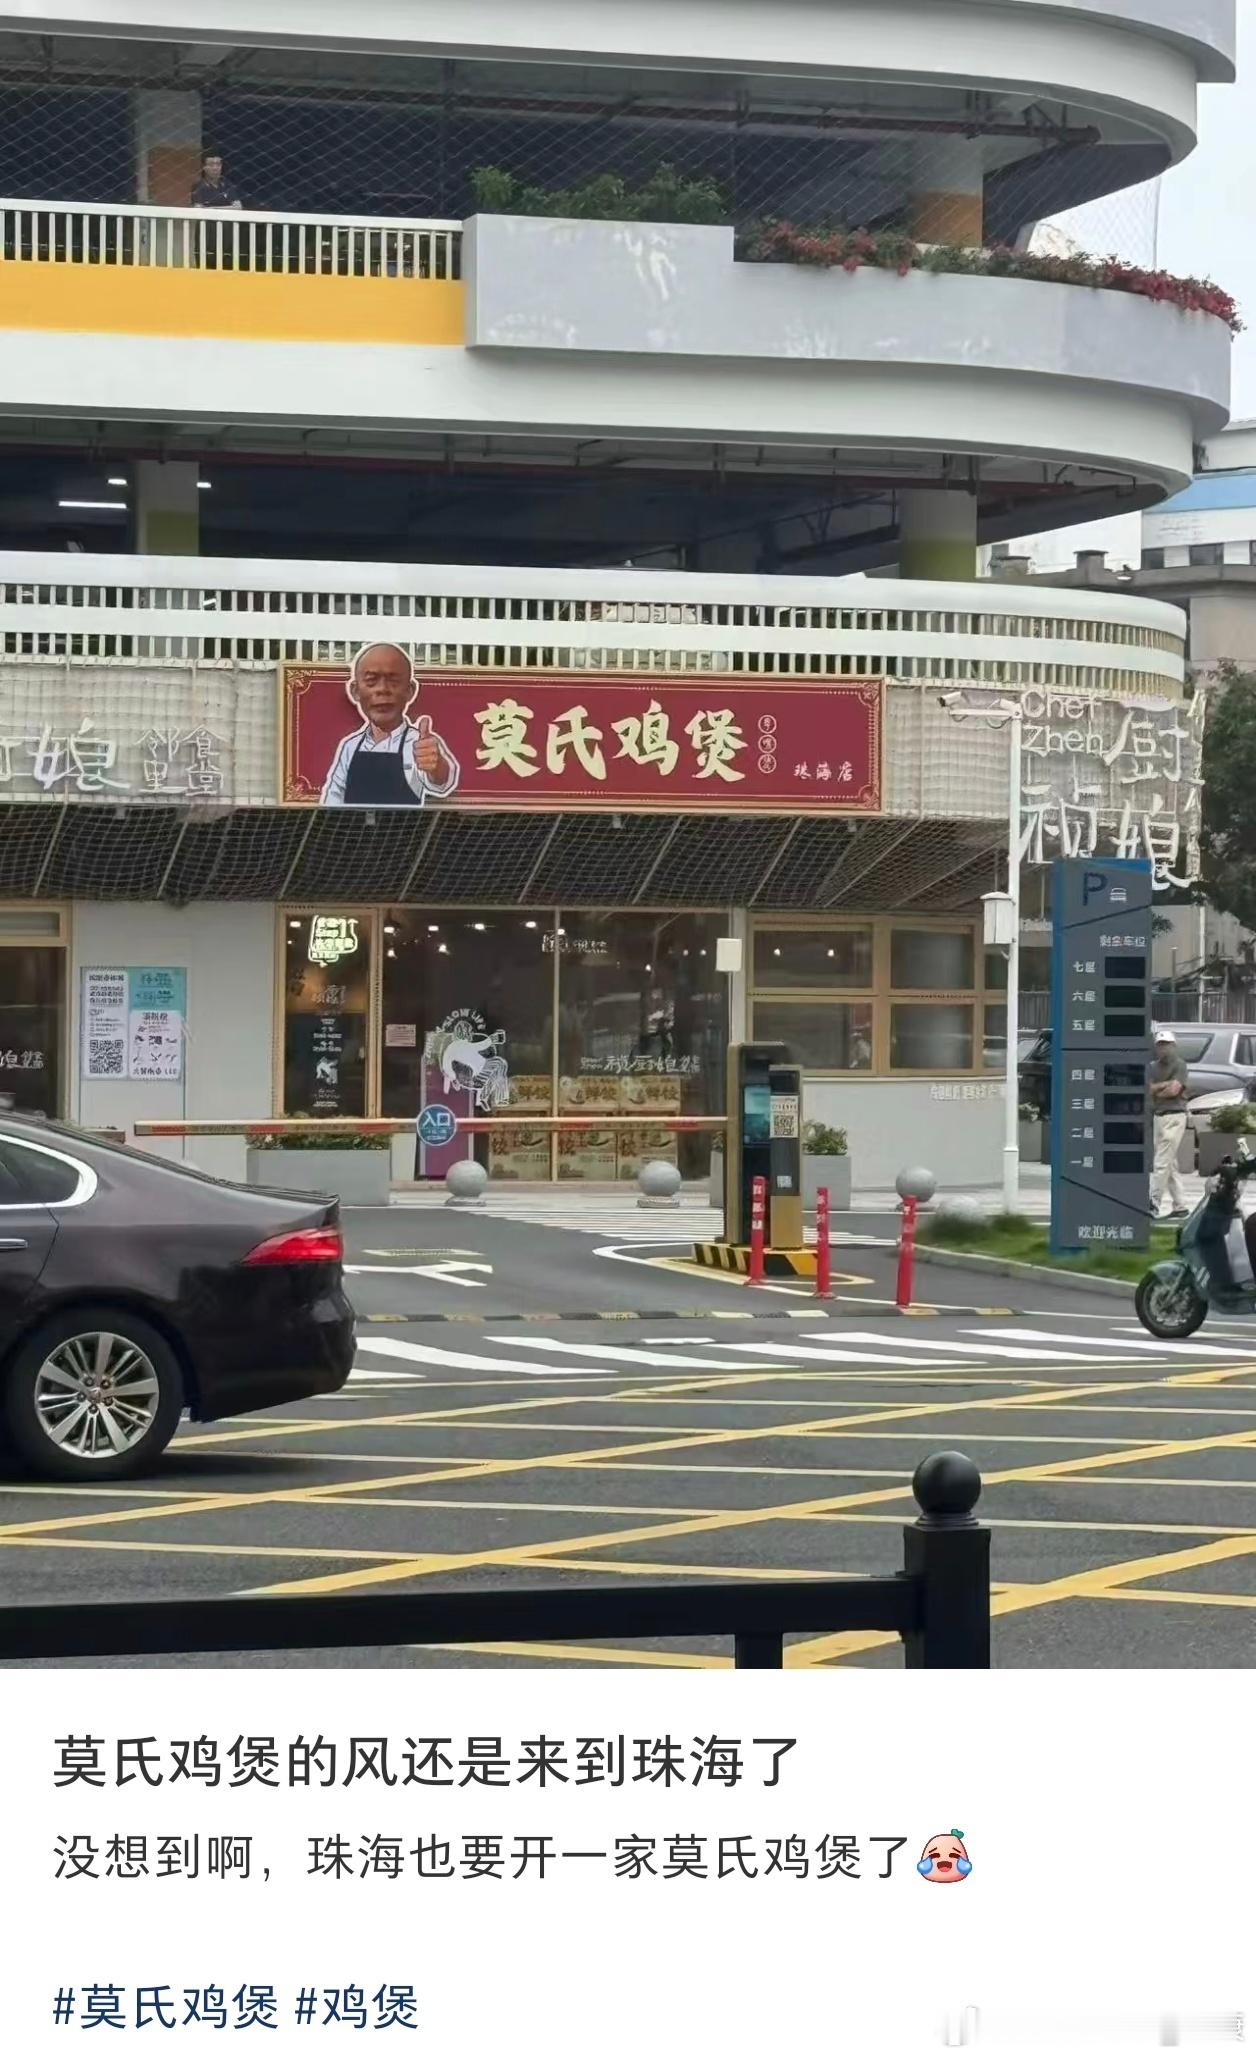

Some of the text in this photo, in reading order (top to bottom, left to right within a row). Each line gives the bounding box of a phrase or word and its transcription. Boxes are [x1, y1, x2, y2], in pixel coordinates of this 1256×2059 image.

[1021, 689, 1102, 719] Chef
[473, 698, 749, 783] 莫氏鸡煲
[1021, 724, 1103, 756] Zhen
[793, 761, 854, 782] 珠海店
[1083, 873, 1107, 906] P
[1099, 935, 1146, 947] 剩余车位
[1073, 961, 1096, 973] 七层
[1072, 991, 1096, 1002] 六层
[1072, 1019, 1096, 1031] 五层
[1071, 1069, 1095, 1081] 四层
[1071, 1098, 1095, 1110] 三层
[422, 1112, 451, 1127] 入口
[1071, 1127, 1095, 1139] 二层
[1070, 1156, 1094, 1168] 一层
[1078, 1224, 1134, 1240] 欢迎光临
